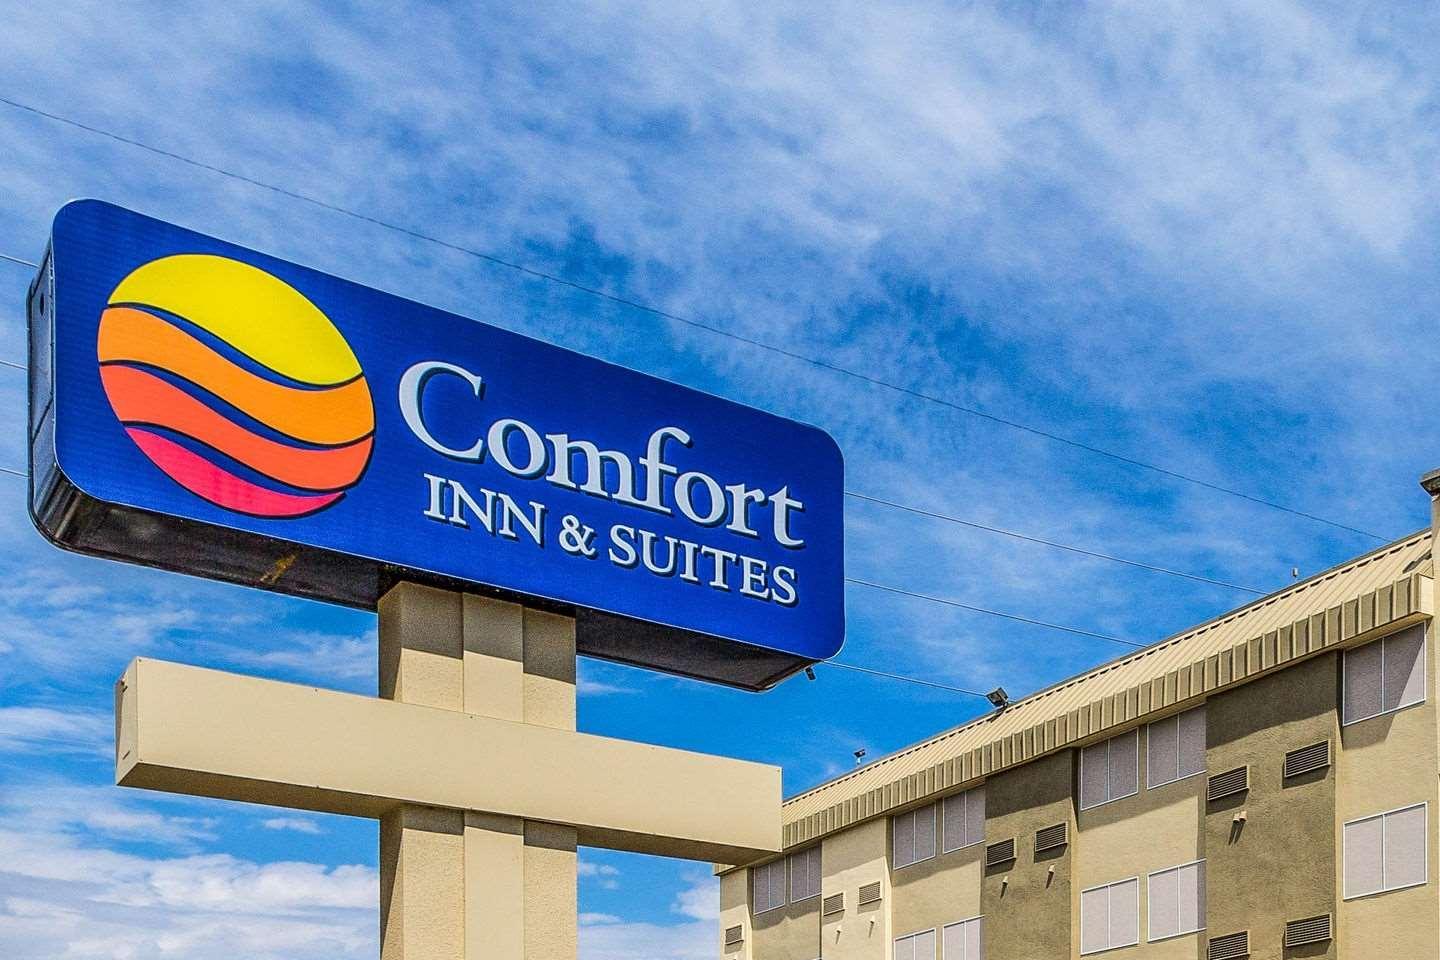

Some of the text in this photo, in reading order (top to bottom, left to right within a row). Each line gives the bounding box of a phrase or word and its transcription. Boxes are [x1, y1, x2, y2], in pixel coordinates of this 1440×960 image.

[398, 360, 805, 547] Comfort
[423, 472, 797, 605] INN & SUITES
